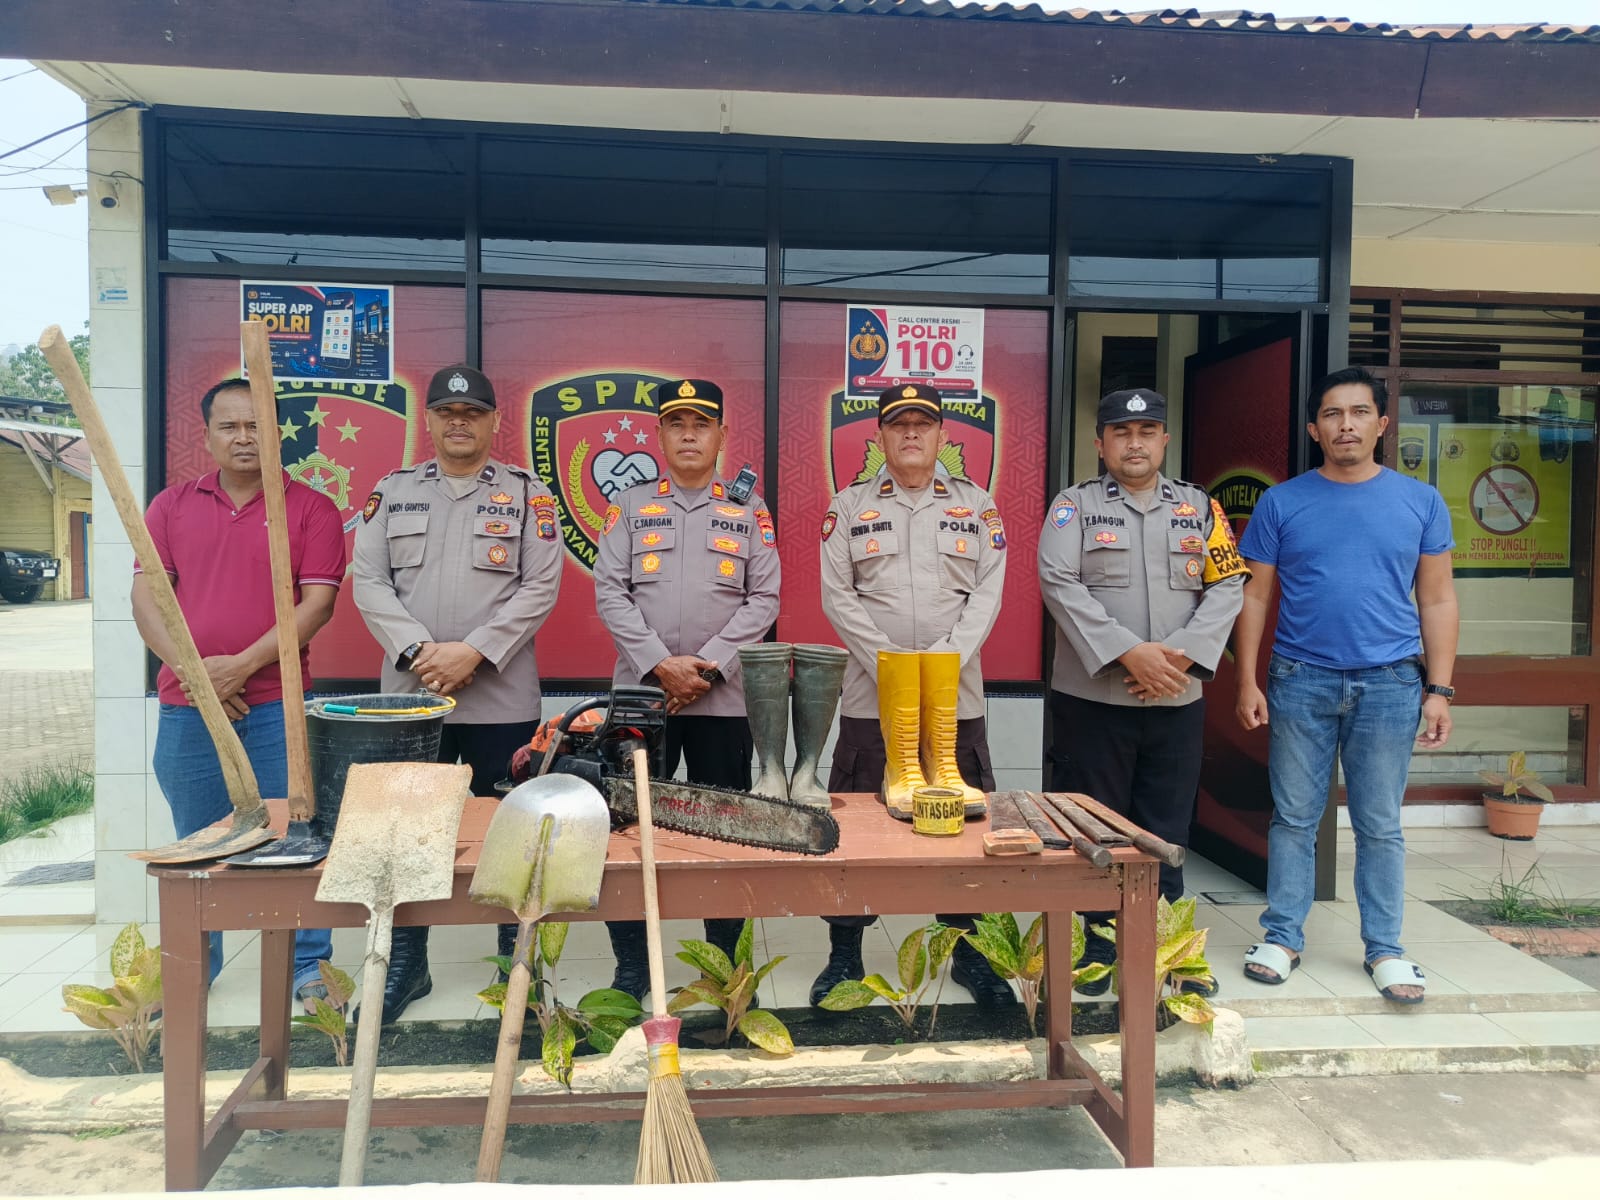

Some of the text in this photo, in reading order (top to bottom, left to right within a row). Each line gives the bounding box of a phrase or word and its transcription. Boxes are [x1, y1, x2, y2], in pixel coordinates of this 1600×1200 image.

[248, 302, 287, 314] SUPER
[289, 303, 314, 315] APP
[898, 324, 956, 340] POLRI
[896, 340, 954, 371] 110
[535, 415, 553, 487] SENTRA
[387, 503, 403, 514] ANDI
[476, 505, 520, 518] POLRI
[634, 517, 673, 530] C.TARIGAN
[711, 519, 749, 534] POLRI
[939, 521, 979, 535] POLRI
[1085, 516, 1125, 527] Y.BANGUN
[1470, 538, 1492, 551] STOP
[1495, 538, 1528, 551] PUNGLI
[1502, 552, 1528, 560] JANGAN
